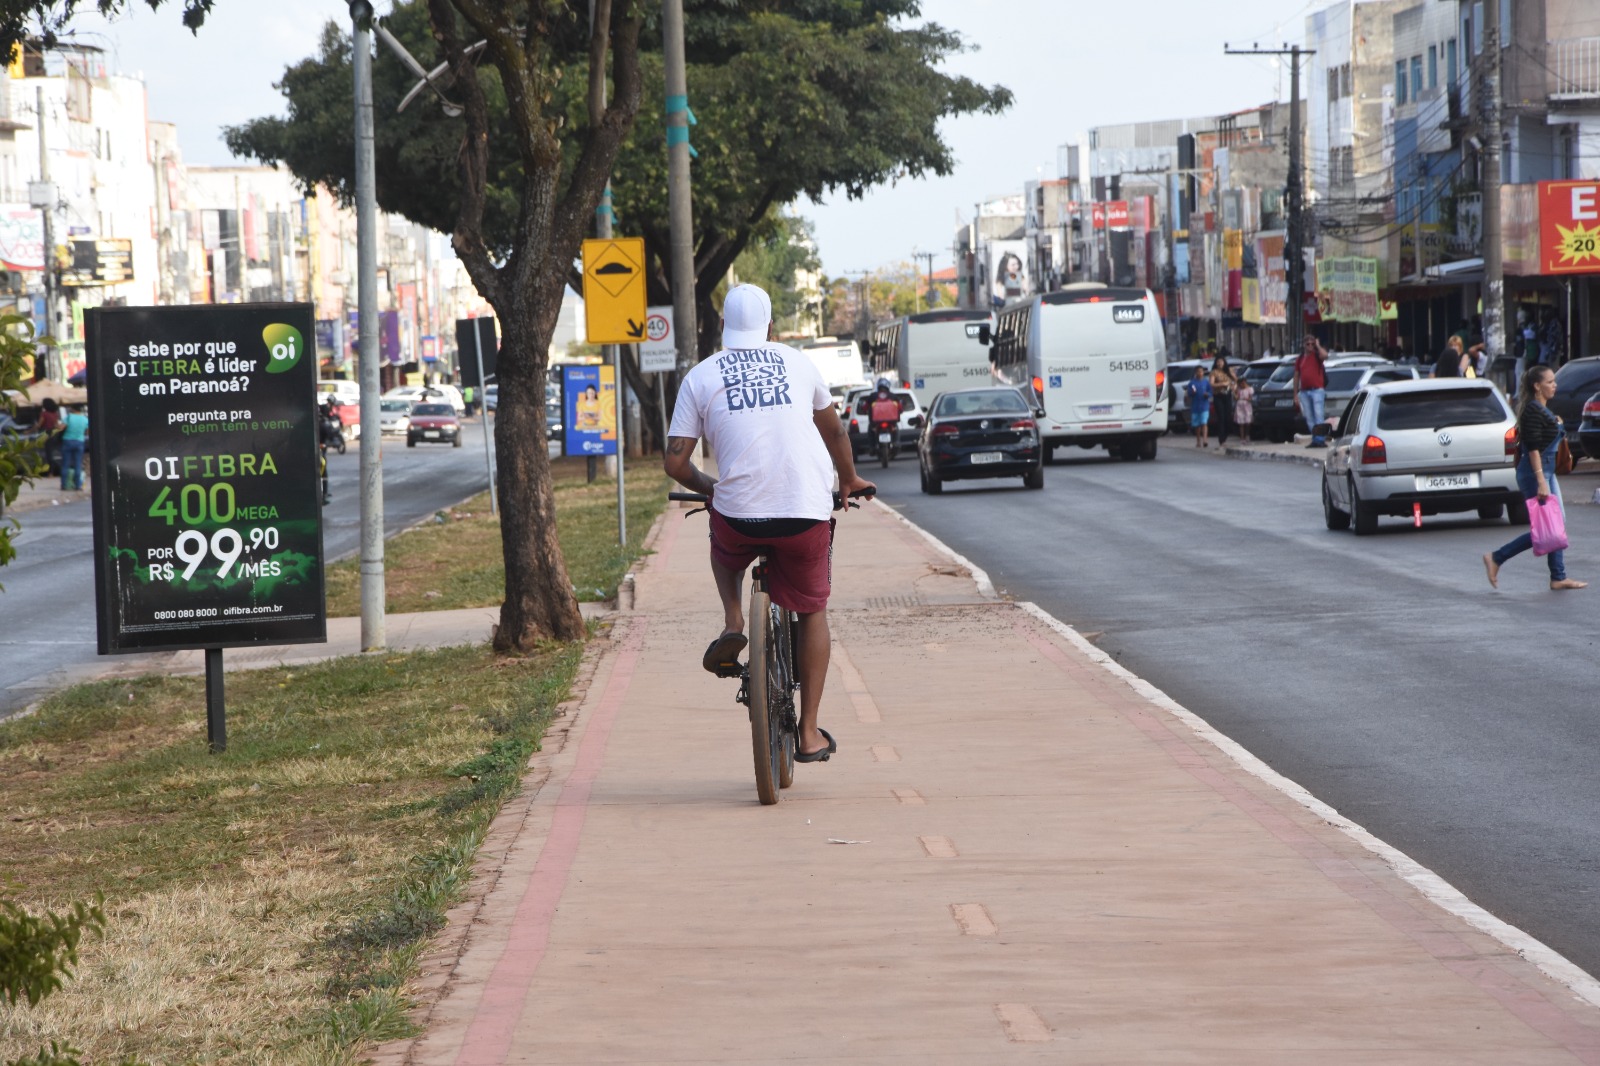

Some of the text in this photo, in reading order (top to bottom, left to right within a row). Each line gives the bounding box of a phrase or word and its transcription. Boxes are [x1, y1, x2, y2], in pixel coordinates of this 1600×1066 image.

[1574, 239, 1595, 252] 20
[647, 319, 665, 331] 40
[128, 341, 237, 359] sabe por que
[272, 336, 295, 360] oi
[204, 359, 215, 373] é
[218, 357, 257, 373] líder
[716, 349, 785, 370] TODAY IS
[1109, 359, 1149, 372] 541583
[720, 362, 759, 375] THE
[722, 365, 787, 388] BEST
[963, 366, 992, 378] 54149
[139, 376, 250, 395] em Paranoá?
[742, 376, 787, 388] DAY
[726, 383, 792, 411] EVER
[168, 408, 252, 424] pergunta pra
[181, 419, 294, 435] quem tem e vem.
[148, 482, 279, 526] 400 MEGA
[147, 548, 174, 560] POR
[149, 561, 175, 582] R$
[154, 604, 283, 620] 0800 080 8000 oifibra.com.br
